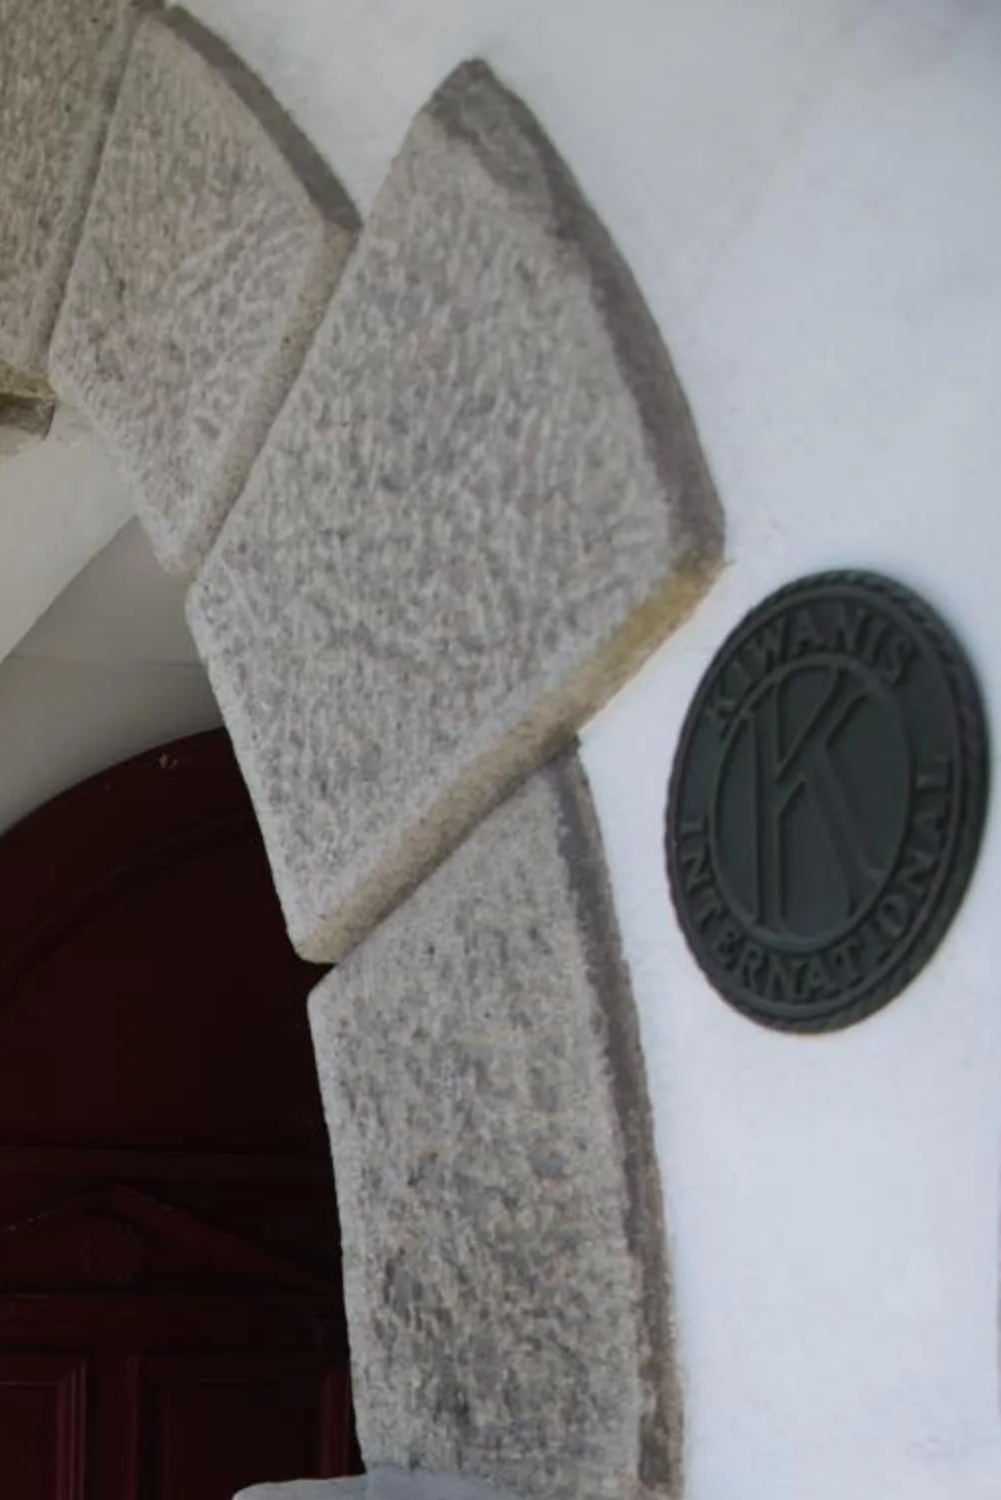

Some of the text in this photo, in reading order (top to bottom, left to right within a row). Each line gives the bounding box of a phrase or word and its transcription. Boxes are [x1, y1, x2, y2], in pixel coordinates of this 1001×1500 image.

[705, 600, 919, 737] KIWANIS
[678, 752, 954, 1000] INTERNATIONAL
[741, 662, 892, 926] K
